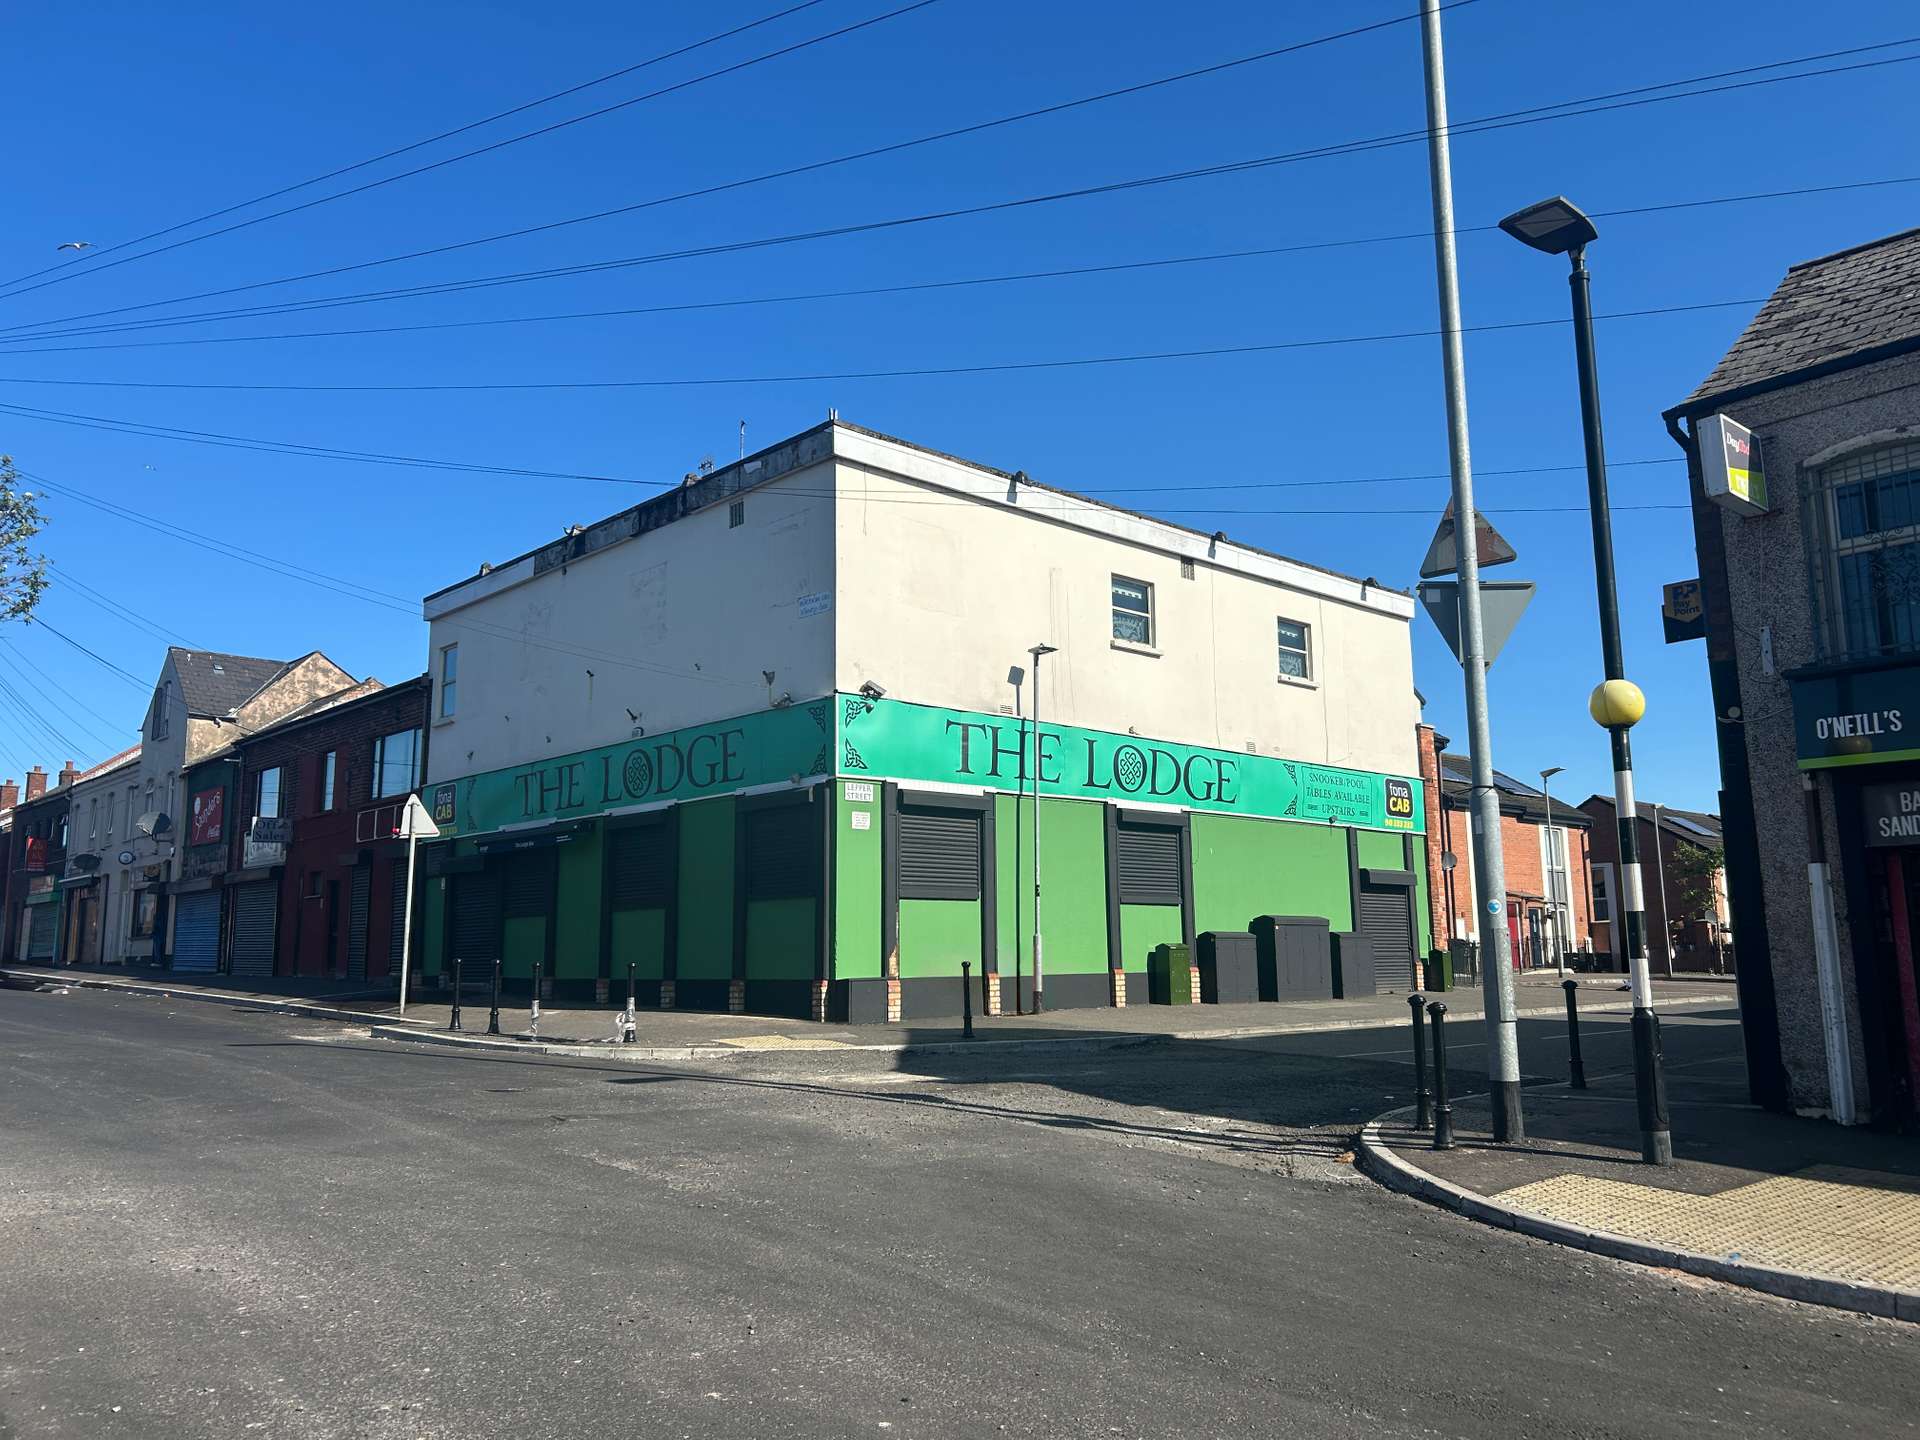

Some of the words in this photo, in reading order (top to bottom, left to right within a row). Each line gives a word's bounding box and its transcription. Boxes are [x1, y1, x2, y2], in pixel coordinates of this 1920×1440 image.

[1816, 710, 1902, 739] O'NEILL'S
[945, 718, 1062, 785] THE
[1082, 737, 1238, 804] LODGE
[514, 762, 585, 816] THE
[600, 728, 746, 804] LODGE
[847, 792, 871, 801] STREET
[1306, 786, 1332, 799] TABLES
[1334, 791, 1370, 804] AVAILABLE
[1389, 783, 1408, 798] fona
[436, 804, 452, 820] CAB
[1321, 804, 1356, 817] UPSTAIRS
[1389, 796, 1410, 813] CAB
